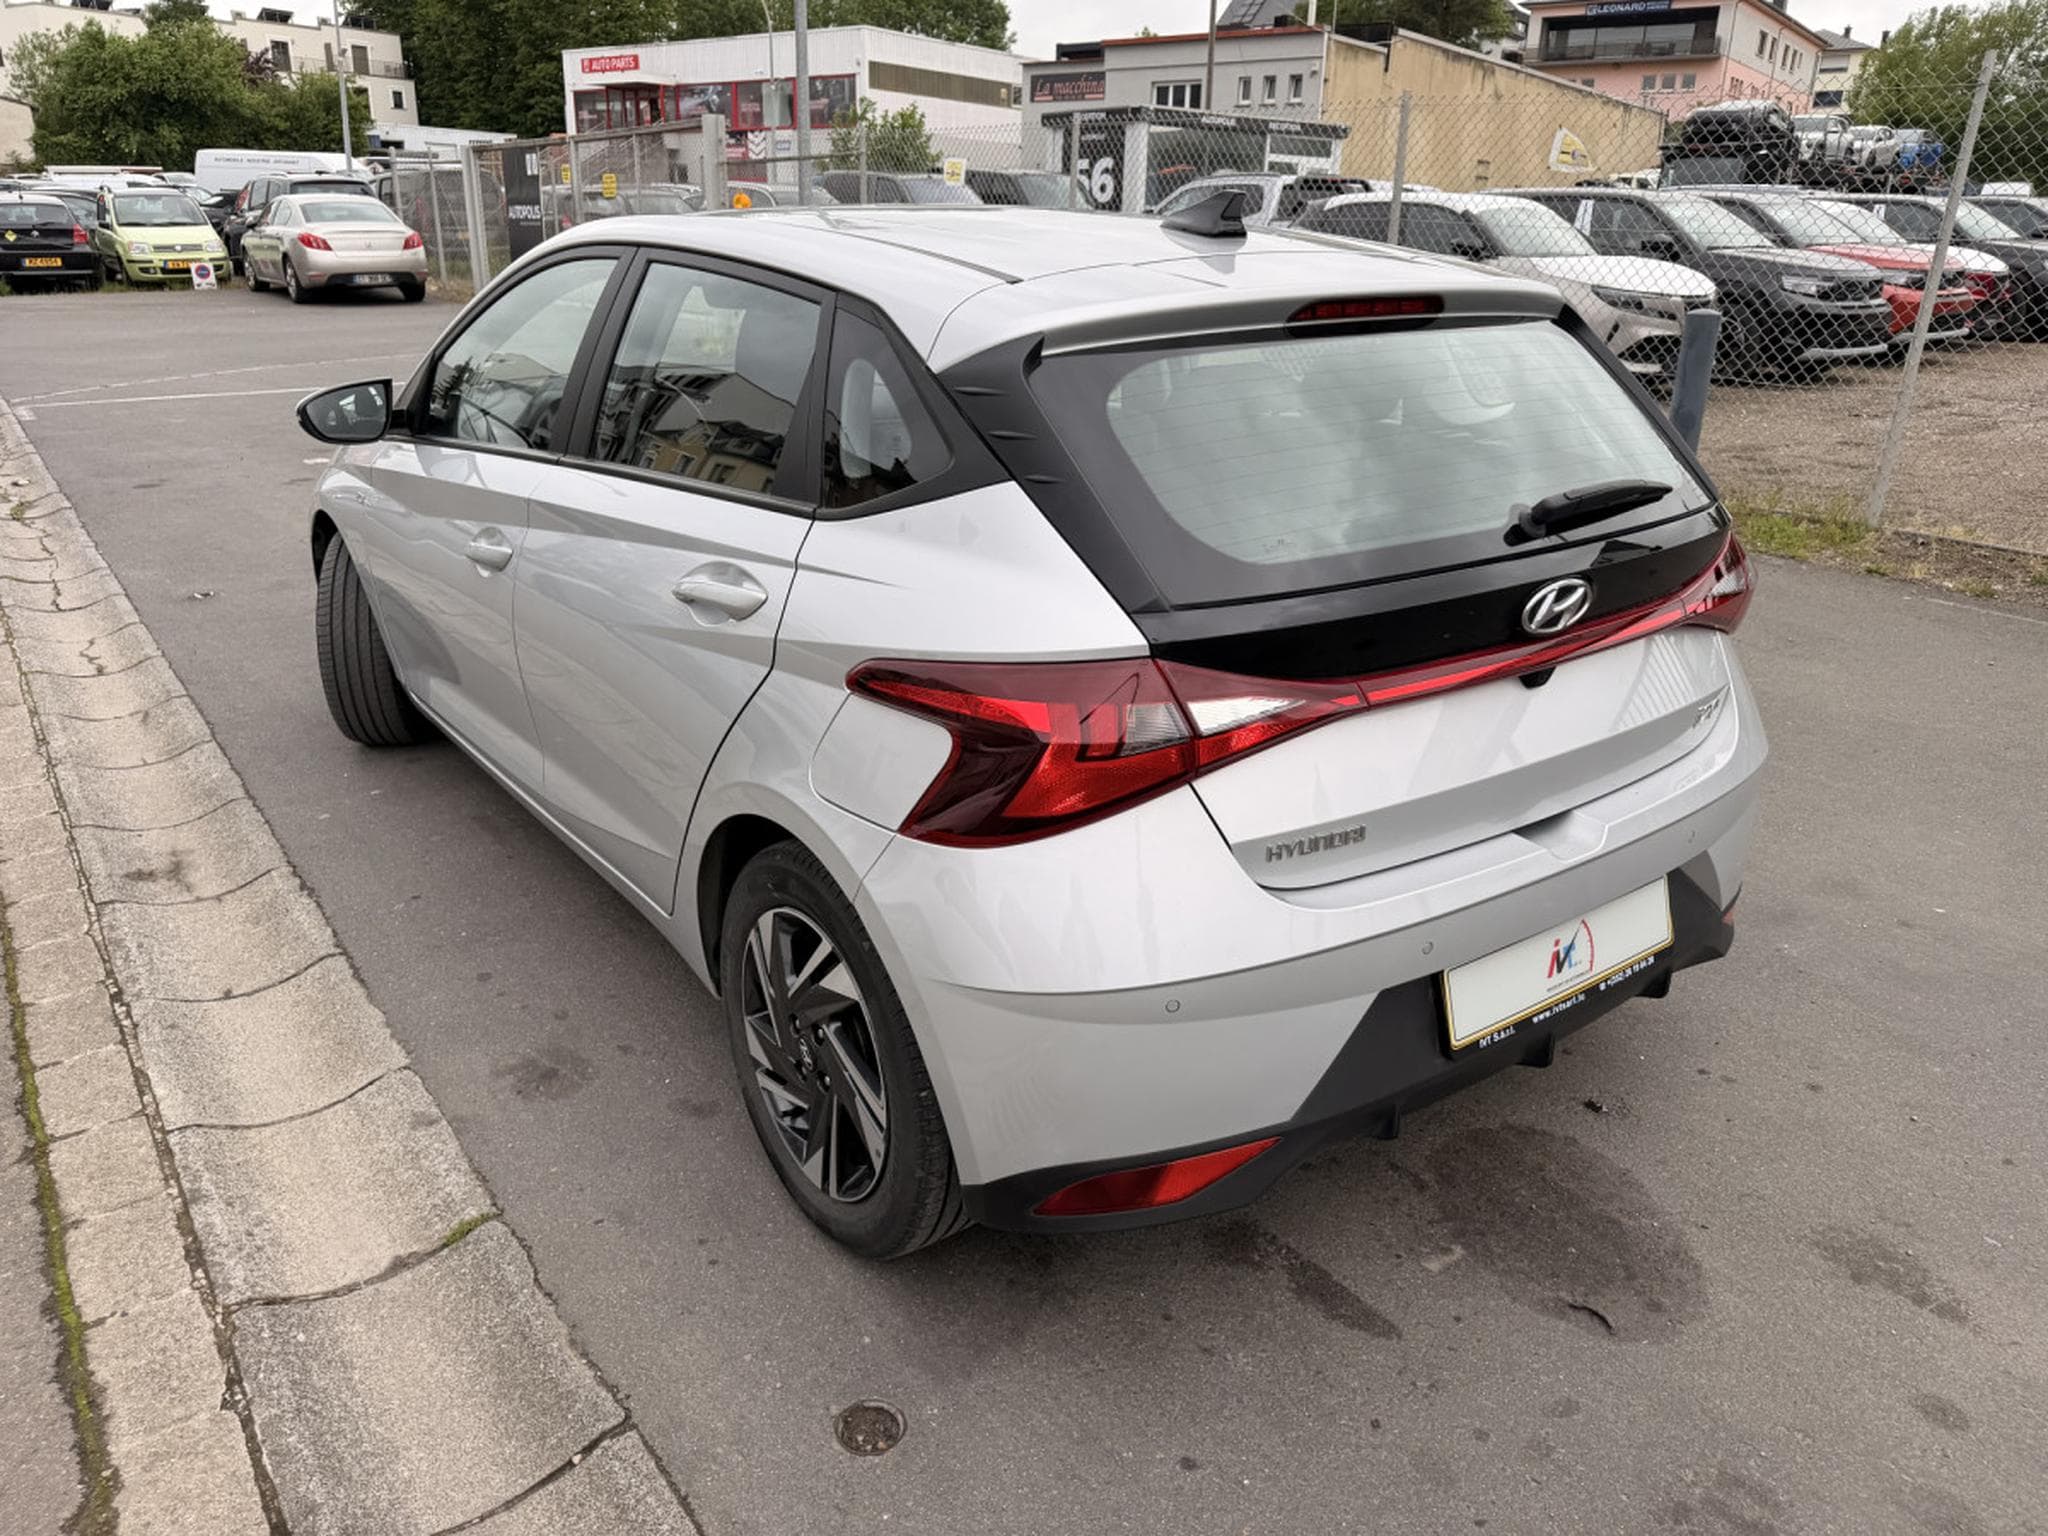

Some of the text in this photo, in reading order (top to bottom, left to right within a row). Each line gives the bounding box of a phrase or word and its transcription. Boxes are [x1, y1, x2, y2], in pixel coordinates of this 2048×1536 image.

[592, 56, 635, 70] AUTO PARTS
[1034, 74, 1104, 95] La macchina
[508, 204, 541, 220] AUTOPOLIS
[1265, 824, 1367, 863] HYUNDAI
